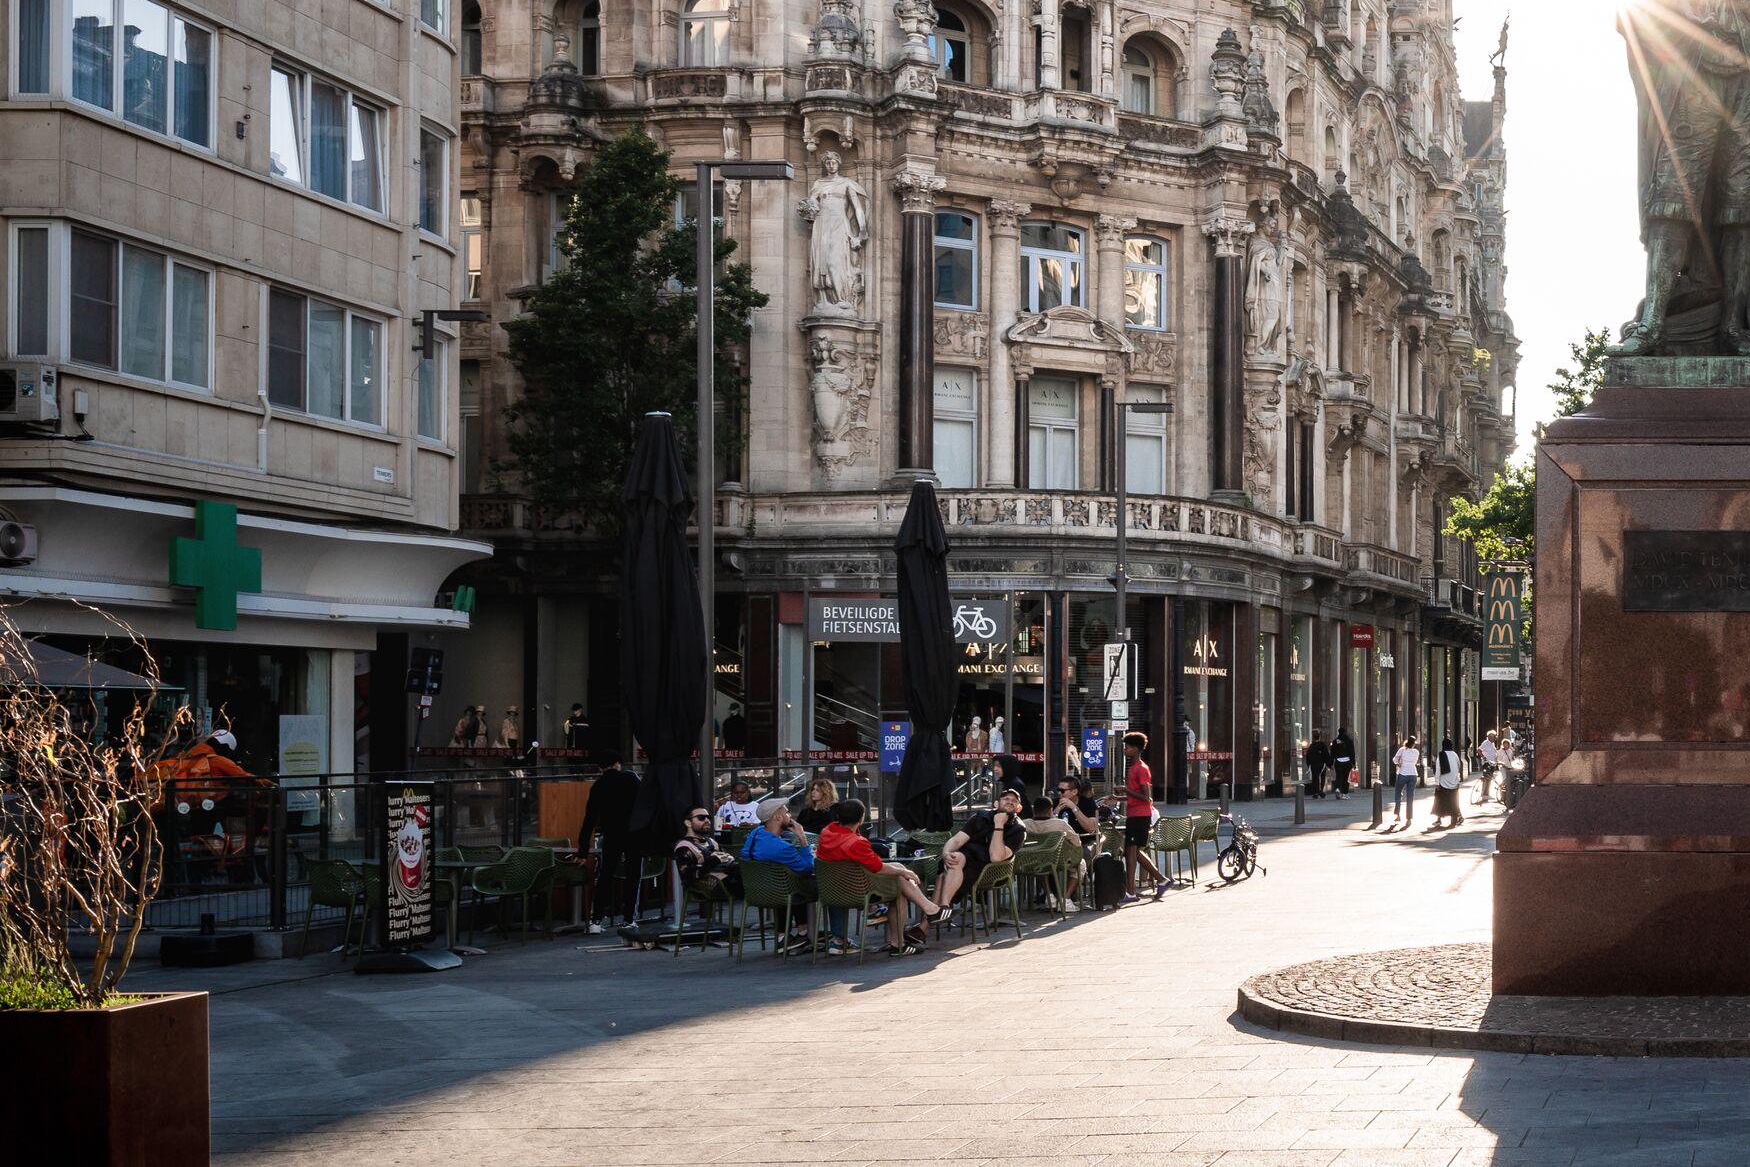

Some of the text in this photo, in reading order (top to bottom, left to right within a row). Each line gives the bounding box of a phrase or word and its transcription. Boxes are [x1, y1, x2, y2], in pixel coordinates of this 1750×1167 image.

[1632, 551, 1692, 566] DAVID
[823, 606, 895, 619] BEVEILIGDE
[823, 621, 900, 634] FIETSENSTAL
[713, 664, 740, 673] ANGE
[957, 664, 1040, 673] MANI EXCANGE
[1183, 666, 1201, 675] RMANI
[884, 735, 906, 743] DROP
[725, 749, 738, 758] SALE
[388, 908, 410, 918] Flurry
[389, 919, 410, 929] Flurry
[389, 930, 410, 941] Flurry
